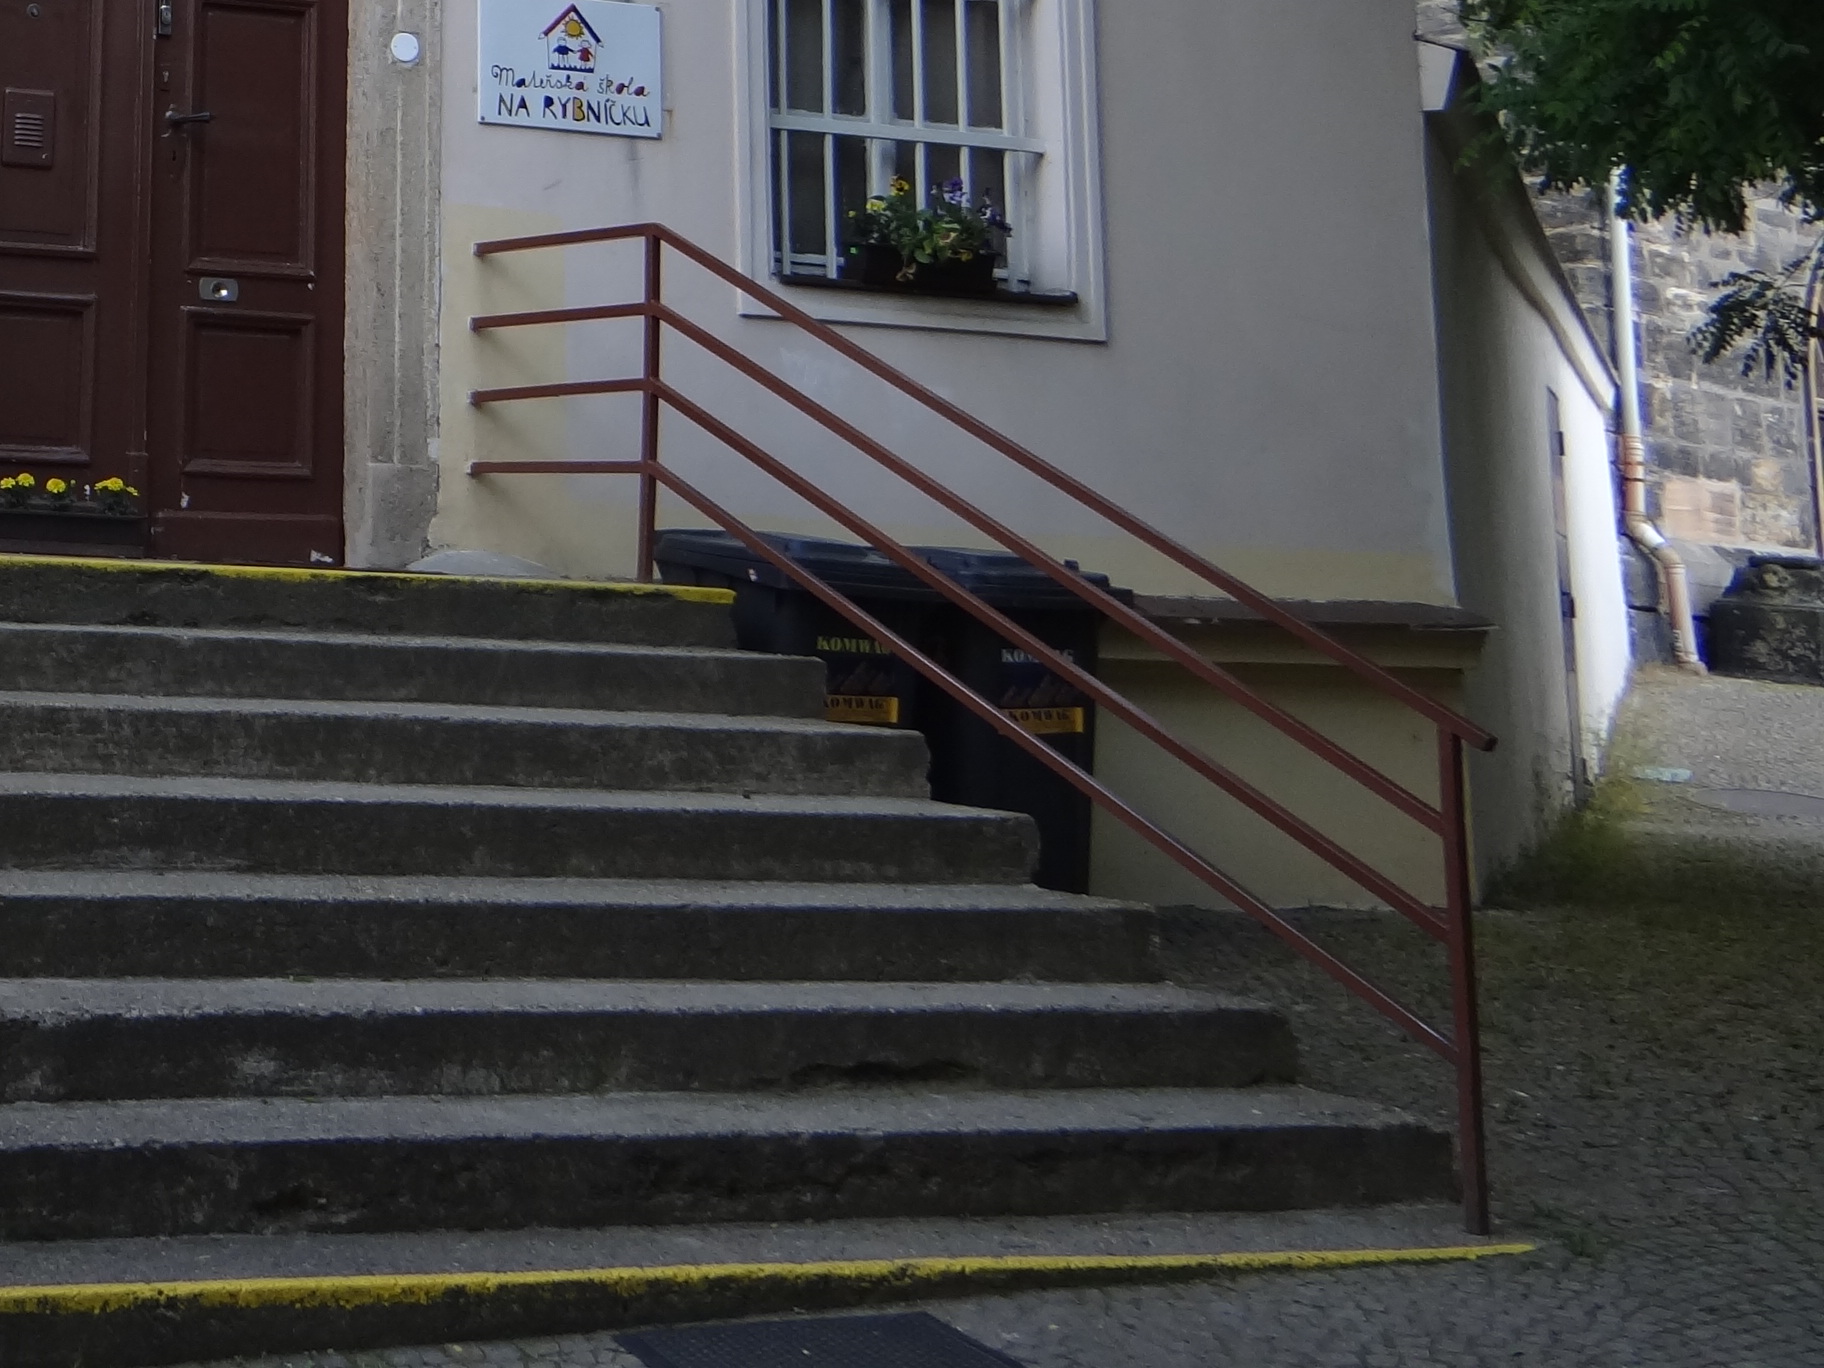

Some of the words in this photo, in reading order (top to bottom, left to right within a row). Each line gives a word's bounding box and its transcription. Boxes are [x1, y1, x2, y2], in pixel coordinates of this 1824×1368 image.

[491, 64, 588, 92] Mateřská
[597, 73, 650, 97] škola
[497, 92, 529, 118] NA
[542, 94, 651, 128] RYBNÍČKU
[816, 635, 890, 655] KOMWA
